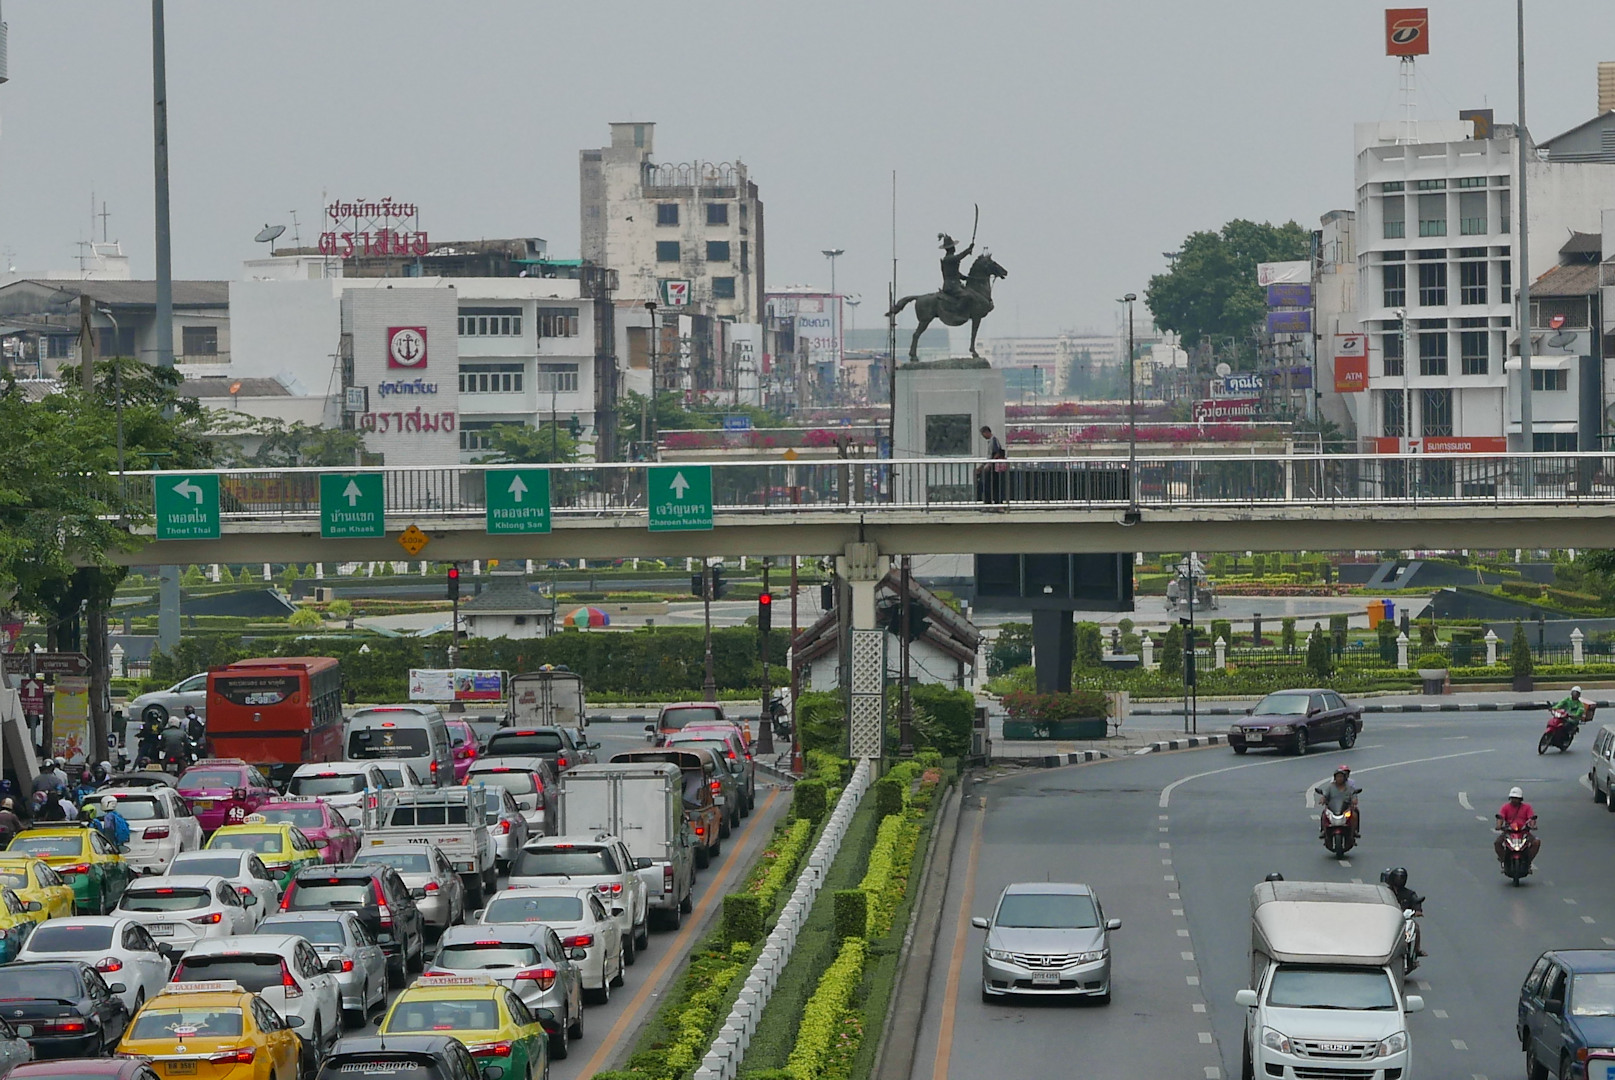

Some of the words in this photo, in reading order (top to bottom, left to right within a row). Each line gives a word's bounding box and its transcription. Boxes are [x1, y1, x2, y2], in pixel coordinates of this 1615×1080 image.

[329, 196, 414, 224] ชุดนักเรียน
[318, 228, 429, 257] ตราสมอ
[1345, 372, 1363, 380] ATM
[361, 405, 455, 433] ตราสมอ
[168, 507, 207, 523] เทอดไท
[330, 509, 375, 522] บ้านแขก
[493, 507, 545, 519] คลองสาน
[656, 502, 705, 518] เจริญนคร
[349, 525, 375, 533] Khaek
[495, 521, 525, 530] Khlong
[228, 807, 245, 819] 49
